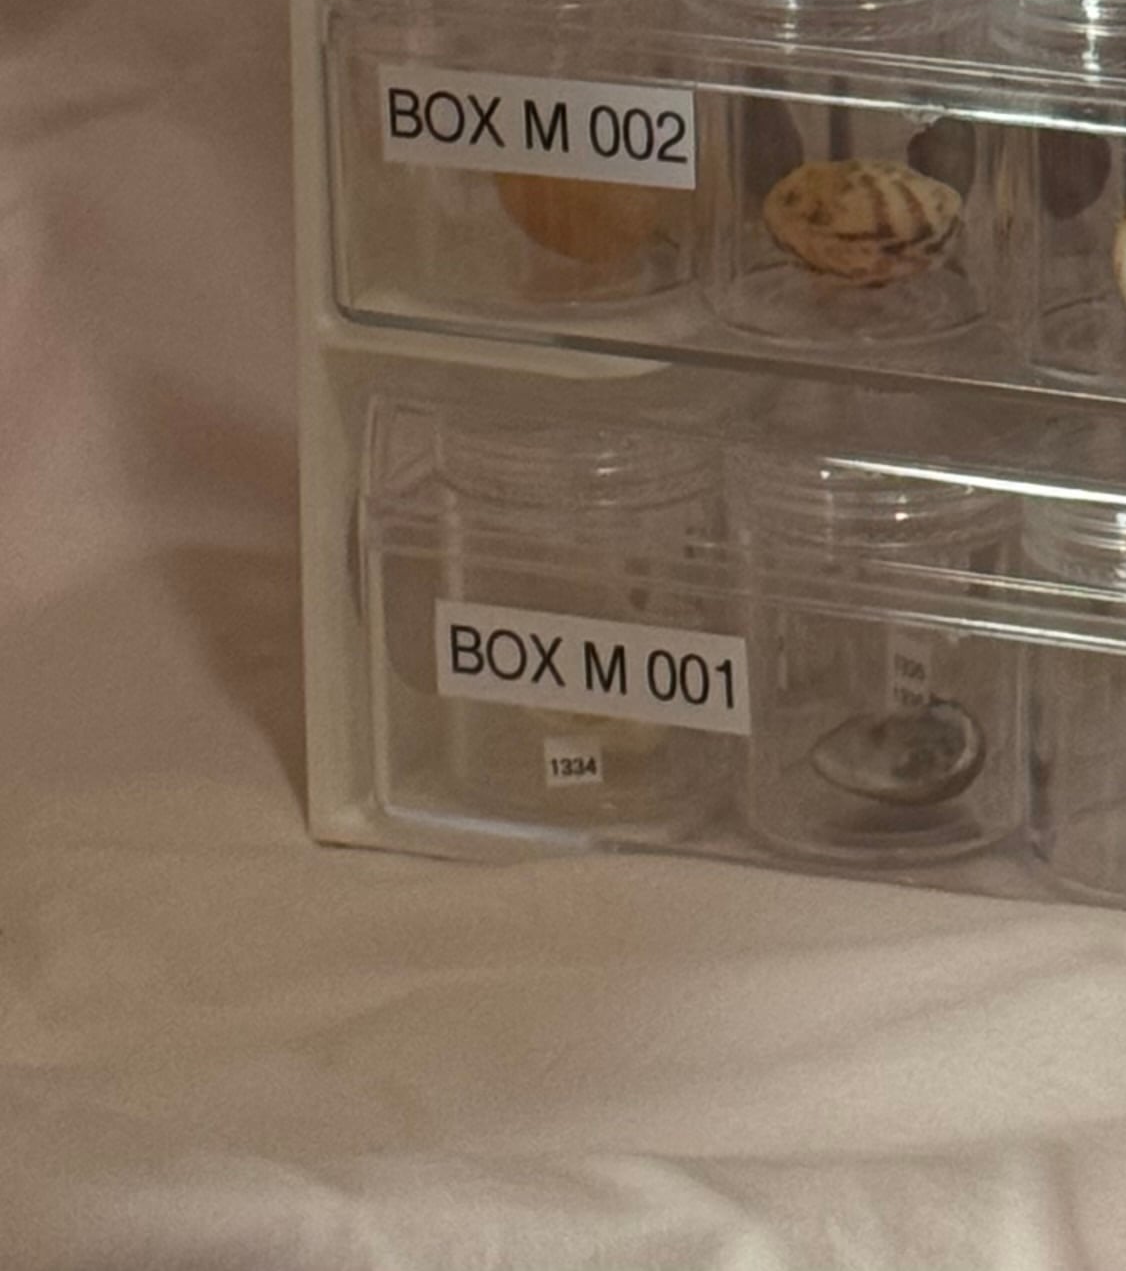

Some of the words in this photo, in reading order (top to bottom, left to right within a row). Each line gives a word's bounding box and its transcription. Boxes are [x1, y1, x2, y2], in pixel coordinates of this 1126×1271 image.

[388, 87, 505, 148] BOX
[524, 99, 569, 153] M
[589, 105, 687, 164] 002
[450, 624, 565, 687] BOX
[584, 641, 627, 695] M
[647, 649, 735, 709] 001
[551, 756, 597, 776] 1334
